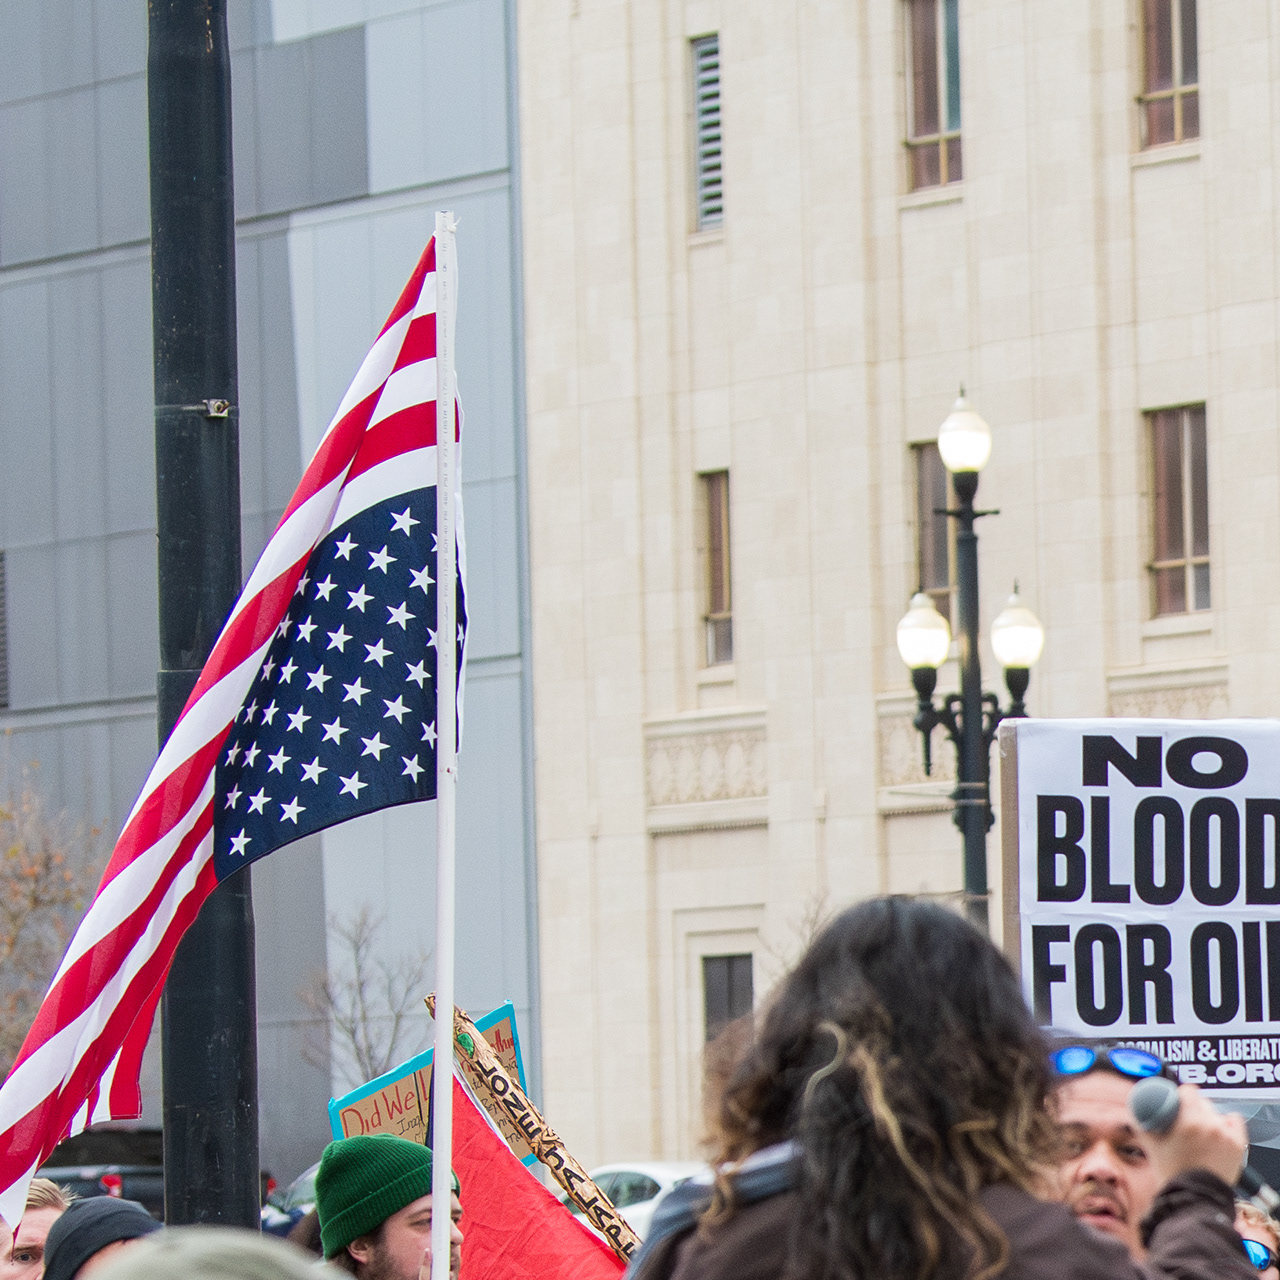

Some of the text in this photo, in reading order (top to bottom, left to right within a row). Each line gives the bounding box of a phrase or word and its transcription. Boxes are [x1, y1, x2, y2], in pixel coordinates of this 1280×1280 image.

[1082, 735, 1249, 789] NO
[1031, 922, 1175, 1028] FOR
[1197, 1039, 1217, 1062] &
[381, 1085, 416, 1121] We
[475, 1059, 542, 1141] LONE
